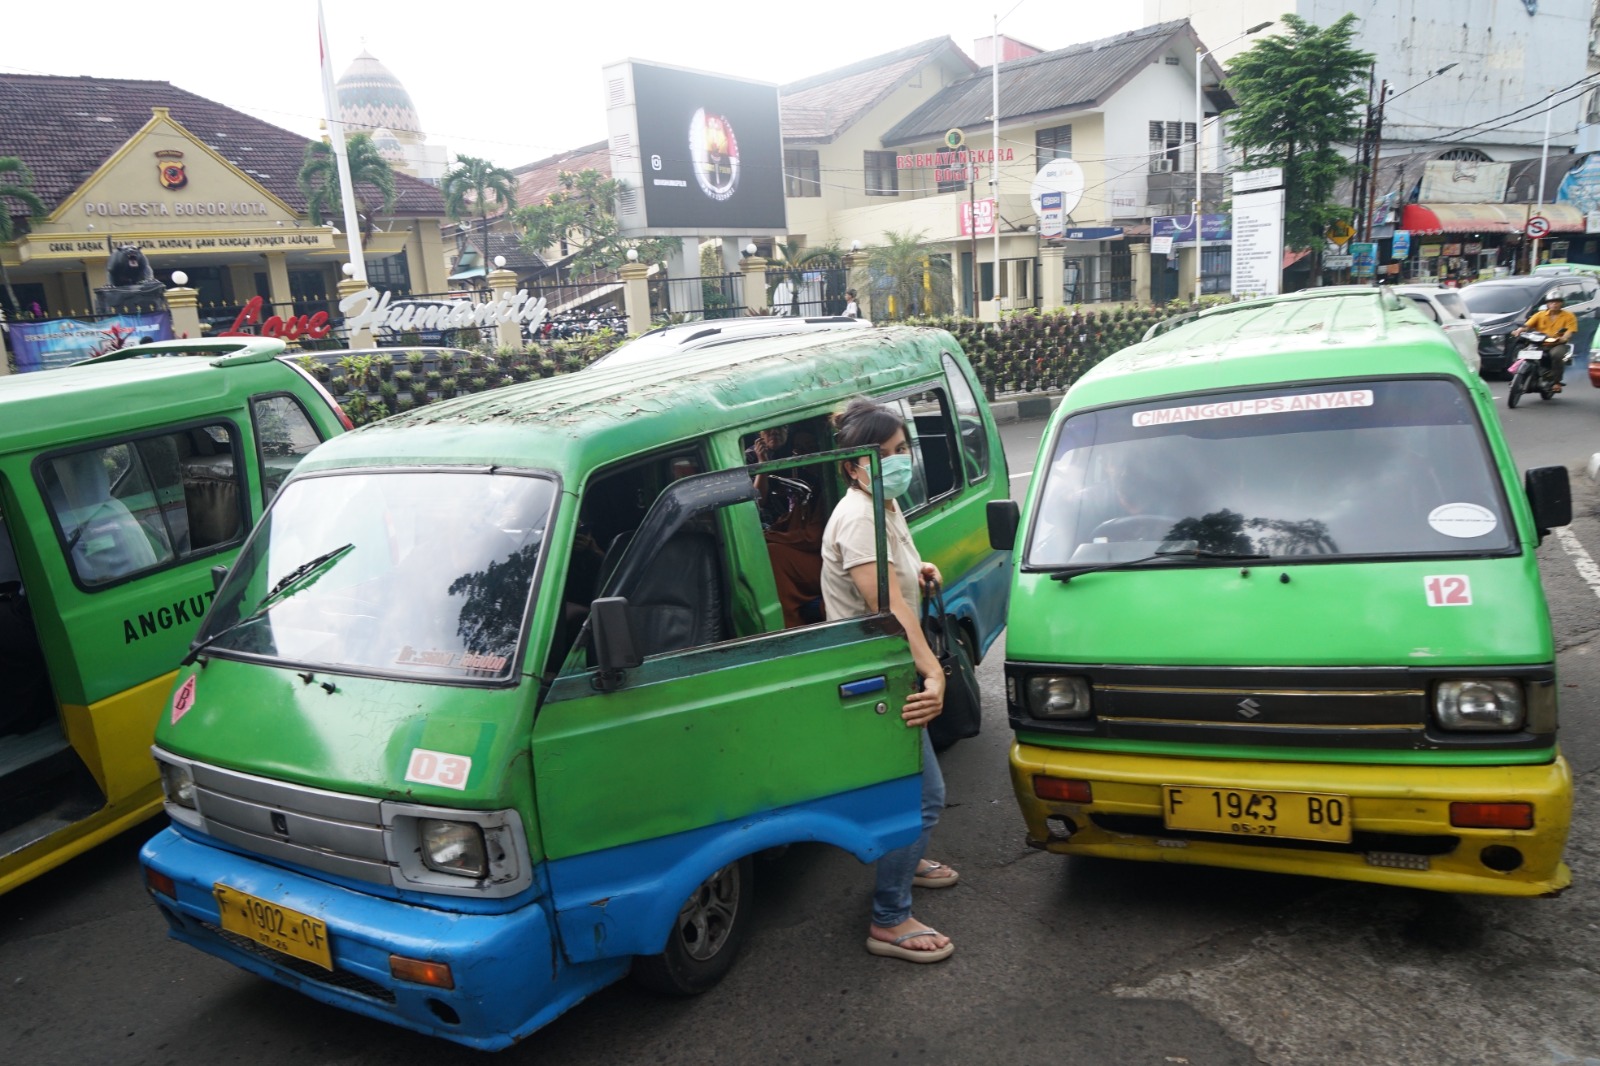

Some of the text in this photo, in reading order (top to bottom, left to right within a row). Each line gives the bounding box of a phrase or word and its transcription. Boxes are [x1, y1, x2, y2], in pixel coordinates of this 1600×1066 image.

[896, 148, 1014, 169] RS BHAYANGKARA
[85, 202, 267, 216] POLRESTA BOGOR KOTA
[218, 287, 548, 340] Love Humanity
[1428, 577, 1469, 604] 12
[411, 753, 467, 785] 03
[1169, 789, 1183, 814] F
[1212, 791, 1277, 821] 1943
[1231, 822, 1277, 834] 05-27
[217, 888, 324, 950] F 1902 CF
